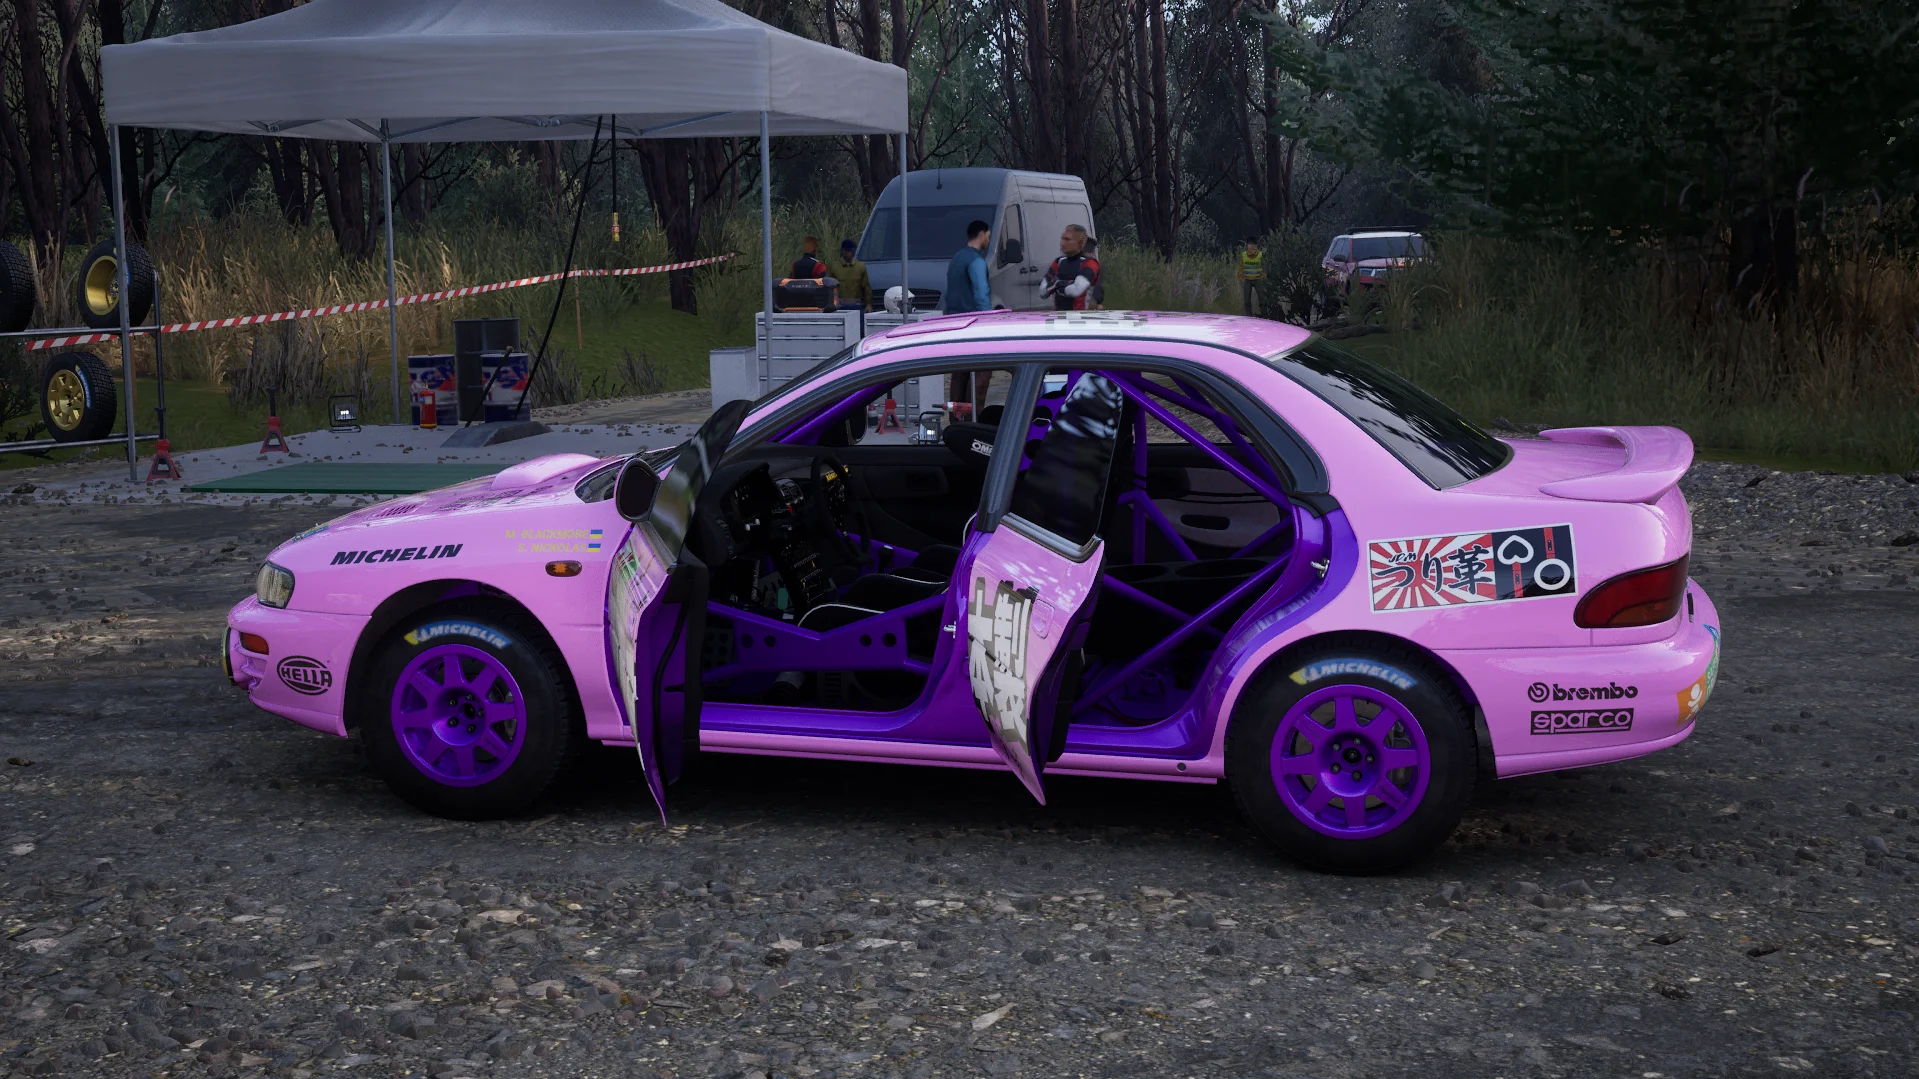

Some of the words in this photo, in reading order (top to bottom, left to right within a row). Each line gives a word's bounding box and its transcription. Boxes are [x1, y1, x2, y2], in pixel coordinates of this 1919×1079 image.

[972, 442, 994, 455] OM
[521, 529, 589, 539] BLACKMORE
[330, 543, 463, 565] MICHELIN
[531, 543, 587, 553] NICKOLAS
[1388, 552, 1417, 563] JDM
[1374, 545, 1494, 595] つり革
[429, 624, 507, 649] MICHELIN
[281, 667, 333, 688] HELLA
[1320, 662, 1412, 690] MICHELIN
[1552, 681, 1639, 701] brembo
[1533, 710, 1632, 733] sparco
